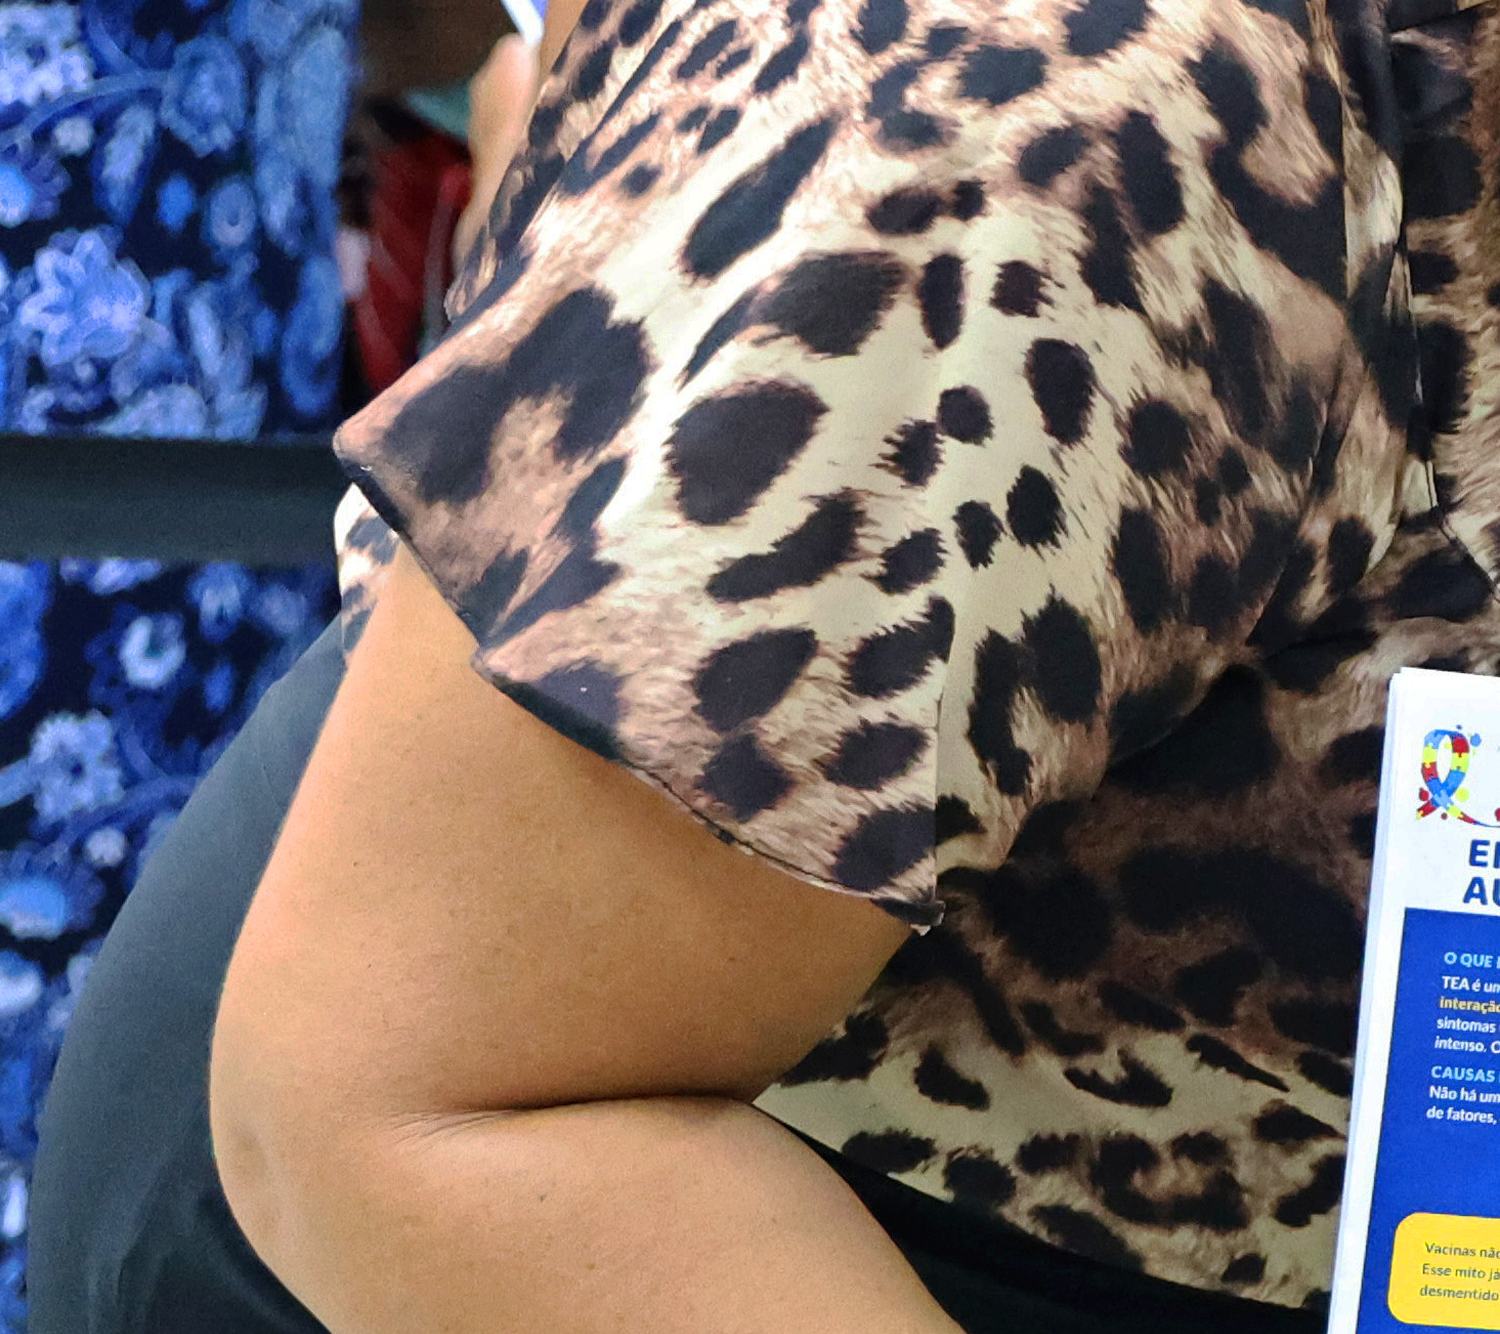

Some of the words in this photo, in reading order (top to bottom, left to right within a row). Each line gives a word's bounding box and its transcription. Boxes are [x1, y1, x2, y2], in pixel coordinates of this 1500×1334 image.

[1444, 951, 1457, 964] O
[1460, 953, 1493, 967] QUE
[1429, 1085, 1457, 1100] Não
[1459, 1087, 1477, 1101] há
[1425, 1242, 1476, 1256] Vacinas
[1422, 1263, 1451, 1276] Esse
[1455, 1268, 1486, 1278] mito
[1487, 1271, 1500, 1282] já
[1419, 1284, 1499, 1301] desmentido
